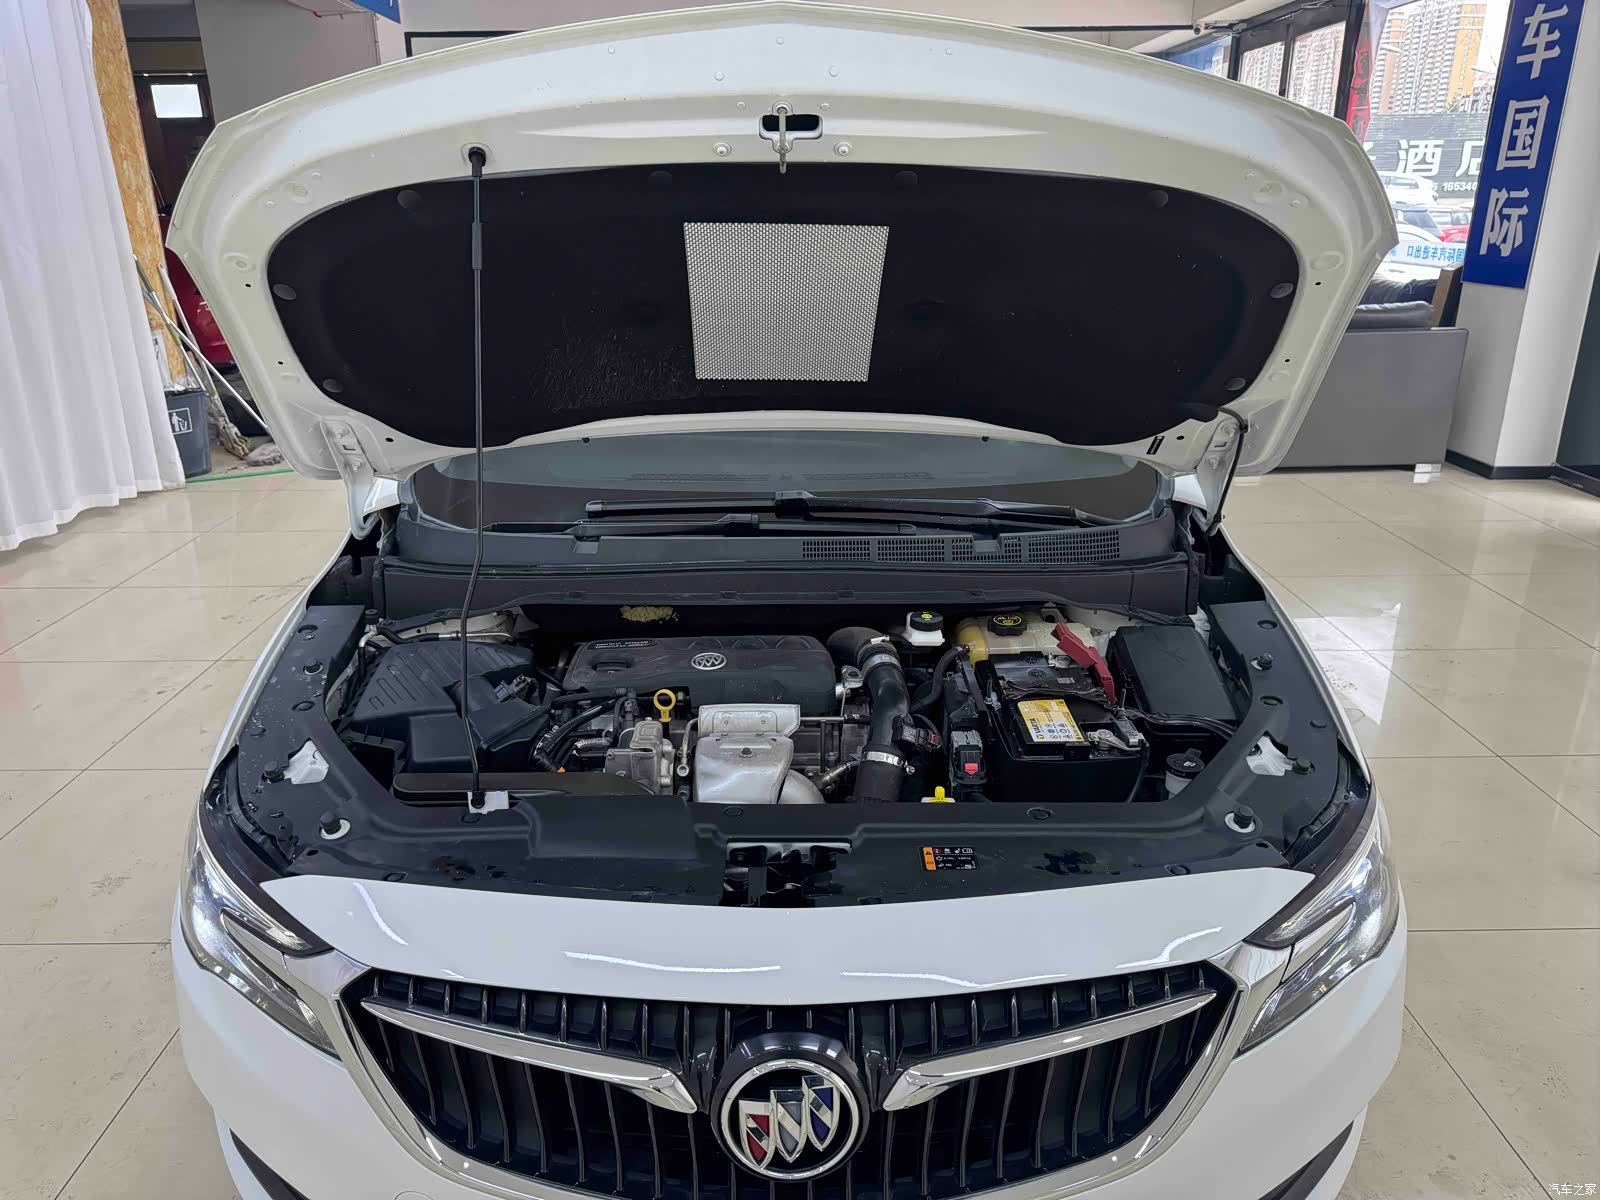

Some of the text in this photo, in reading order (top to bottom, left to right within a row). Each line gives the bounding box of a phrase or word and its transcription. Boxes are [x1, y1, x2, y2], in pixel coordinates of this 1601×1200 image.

[1362, 139, 1485, 178] 酒店
[1479, 3, 1569, 258] 车国际
